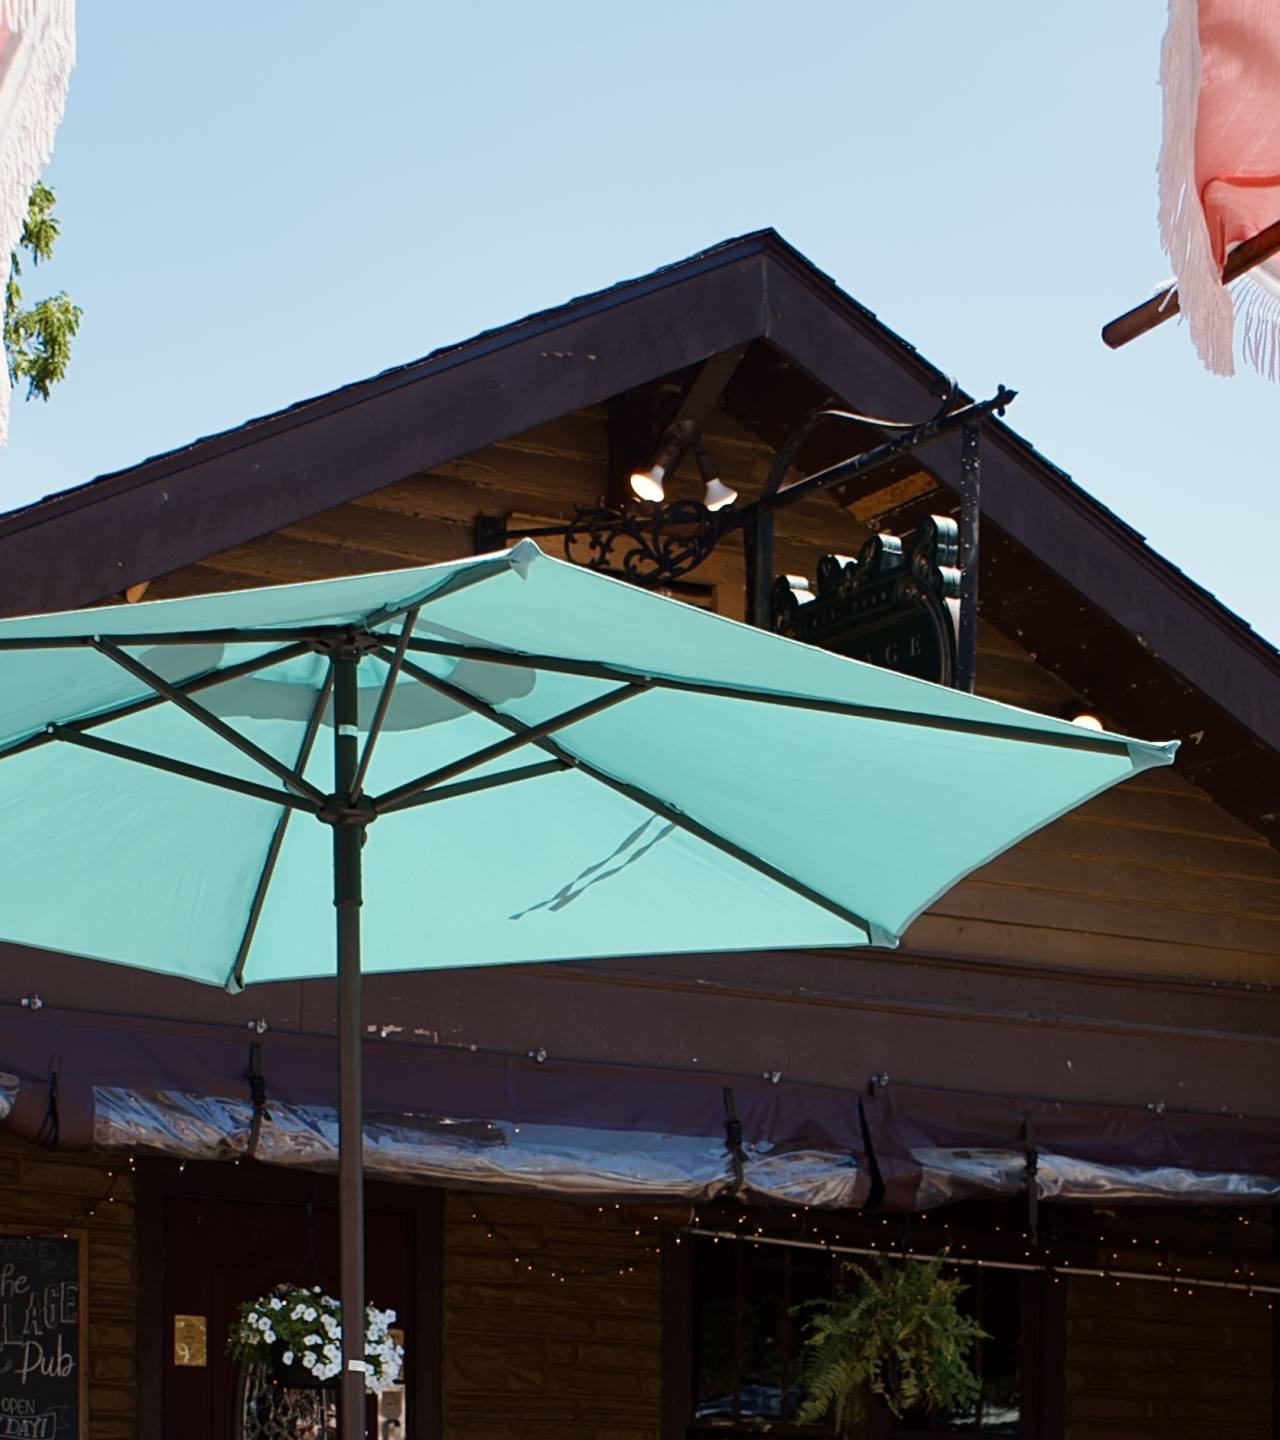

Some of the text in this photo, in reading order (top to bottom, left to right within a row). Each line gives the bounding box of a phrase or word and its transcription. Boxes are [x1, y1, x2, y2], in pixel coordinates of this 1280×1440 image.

[14, 1334, 76, 1384] Pub
[1, 1397, 36, 1414] OPEN
[4, 1417, 49, 1440] DAY!
